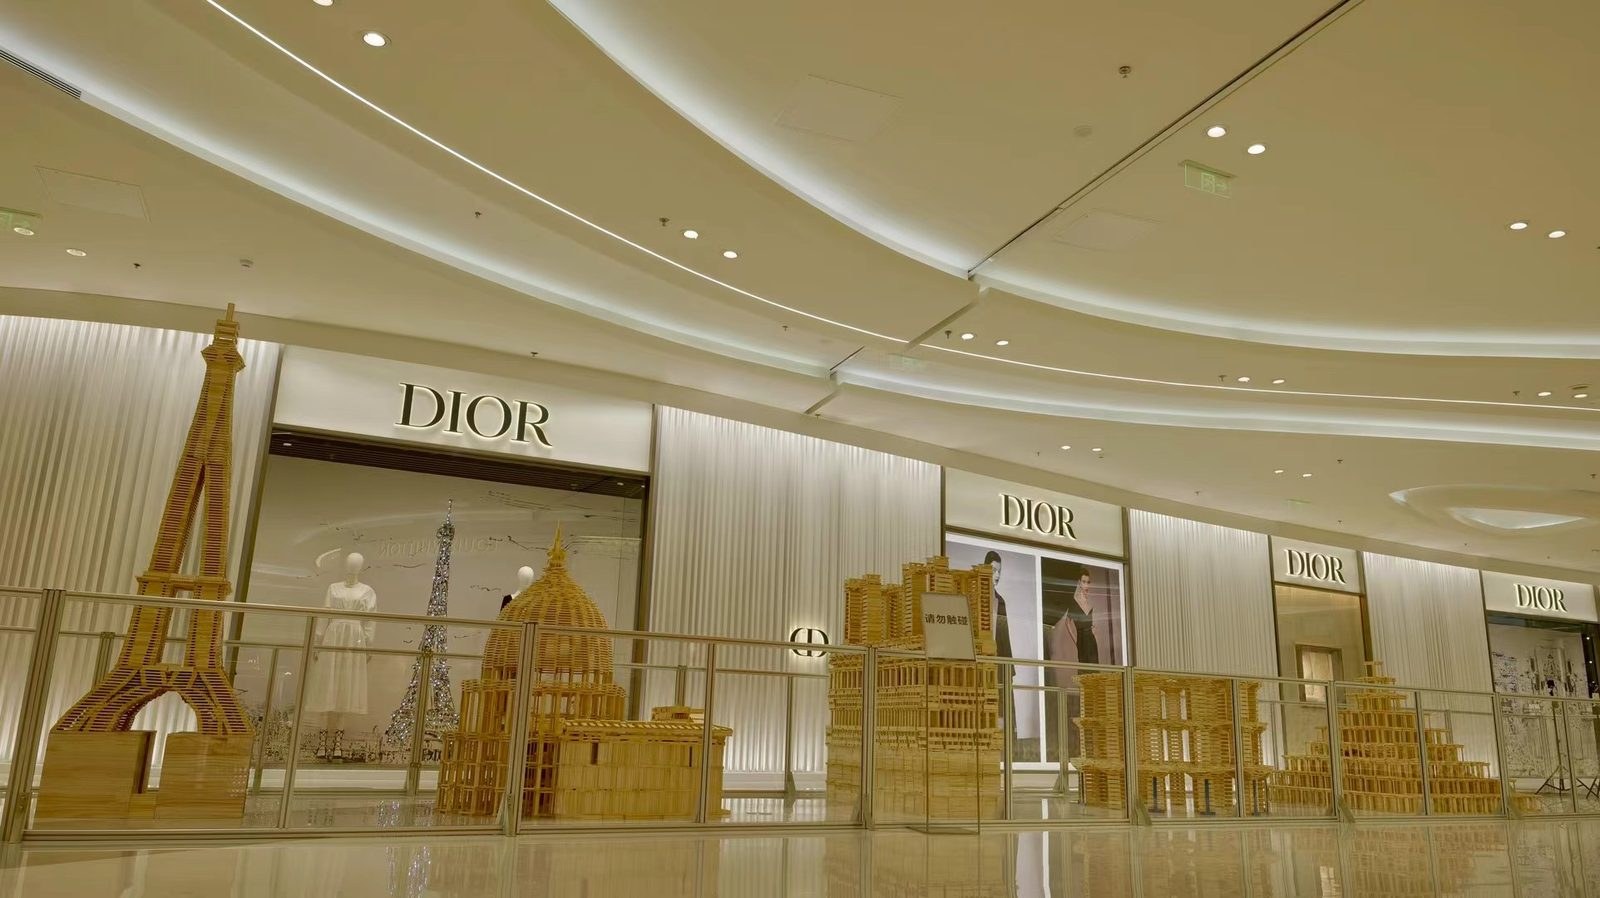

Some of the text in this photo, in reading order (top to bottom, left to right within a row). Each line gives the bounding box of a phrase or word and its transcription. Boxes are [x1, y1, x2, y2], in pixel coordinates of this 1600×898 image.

[394, 382, 553, 448] DIOR
[999, 493, 1077, 540] DIOR
[1284, 549, 1346, 584] DIOR
[1513, 583, 1568, 613] DIOR
[924, 613, 969, 626] 请勿触碰
